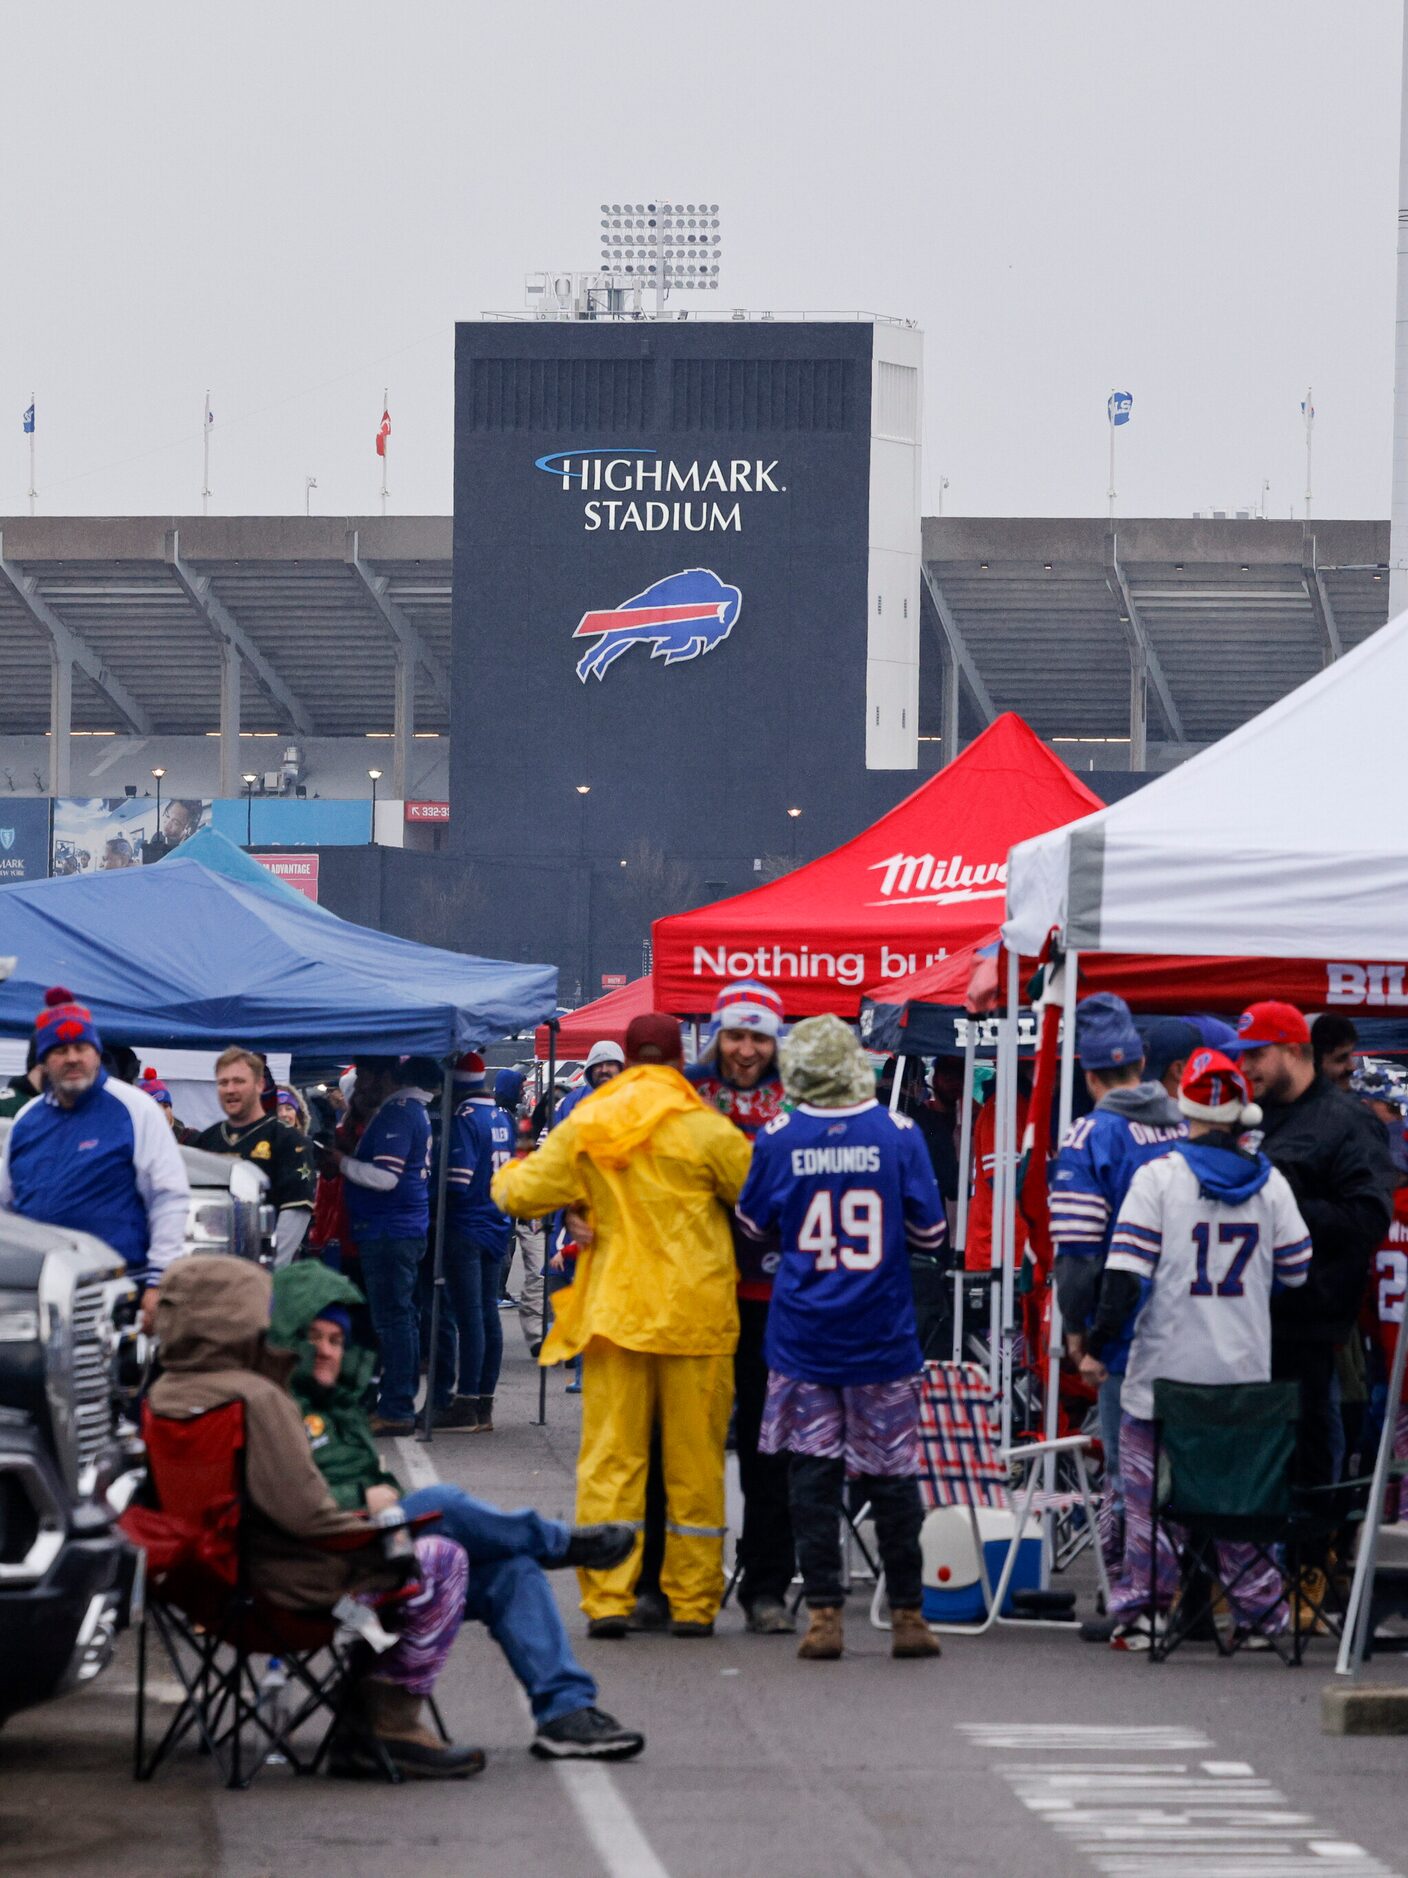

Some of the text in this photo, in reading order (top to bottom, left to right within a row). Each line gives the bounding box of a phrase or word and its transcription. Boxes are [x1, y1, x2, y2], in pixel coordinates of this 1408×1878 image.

[584, 501, 742, 532] STADIUM
[693, 945, 865, 986] Nothing
[791, 1146, 881, 1177] EDMUNDS
[798, 1189, 883, 1272] 49
[1189, 1221, 1260, 1297] 17
